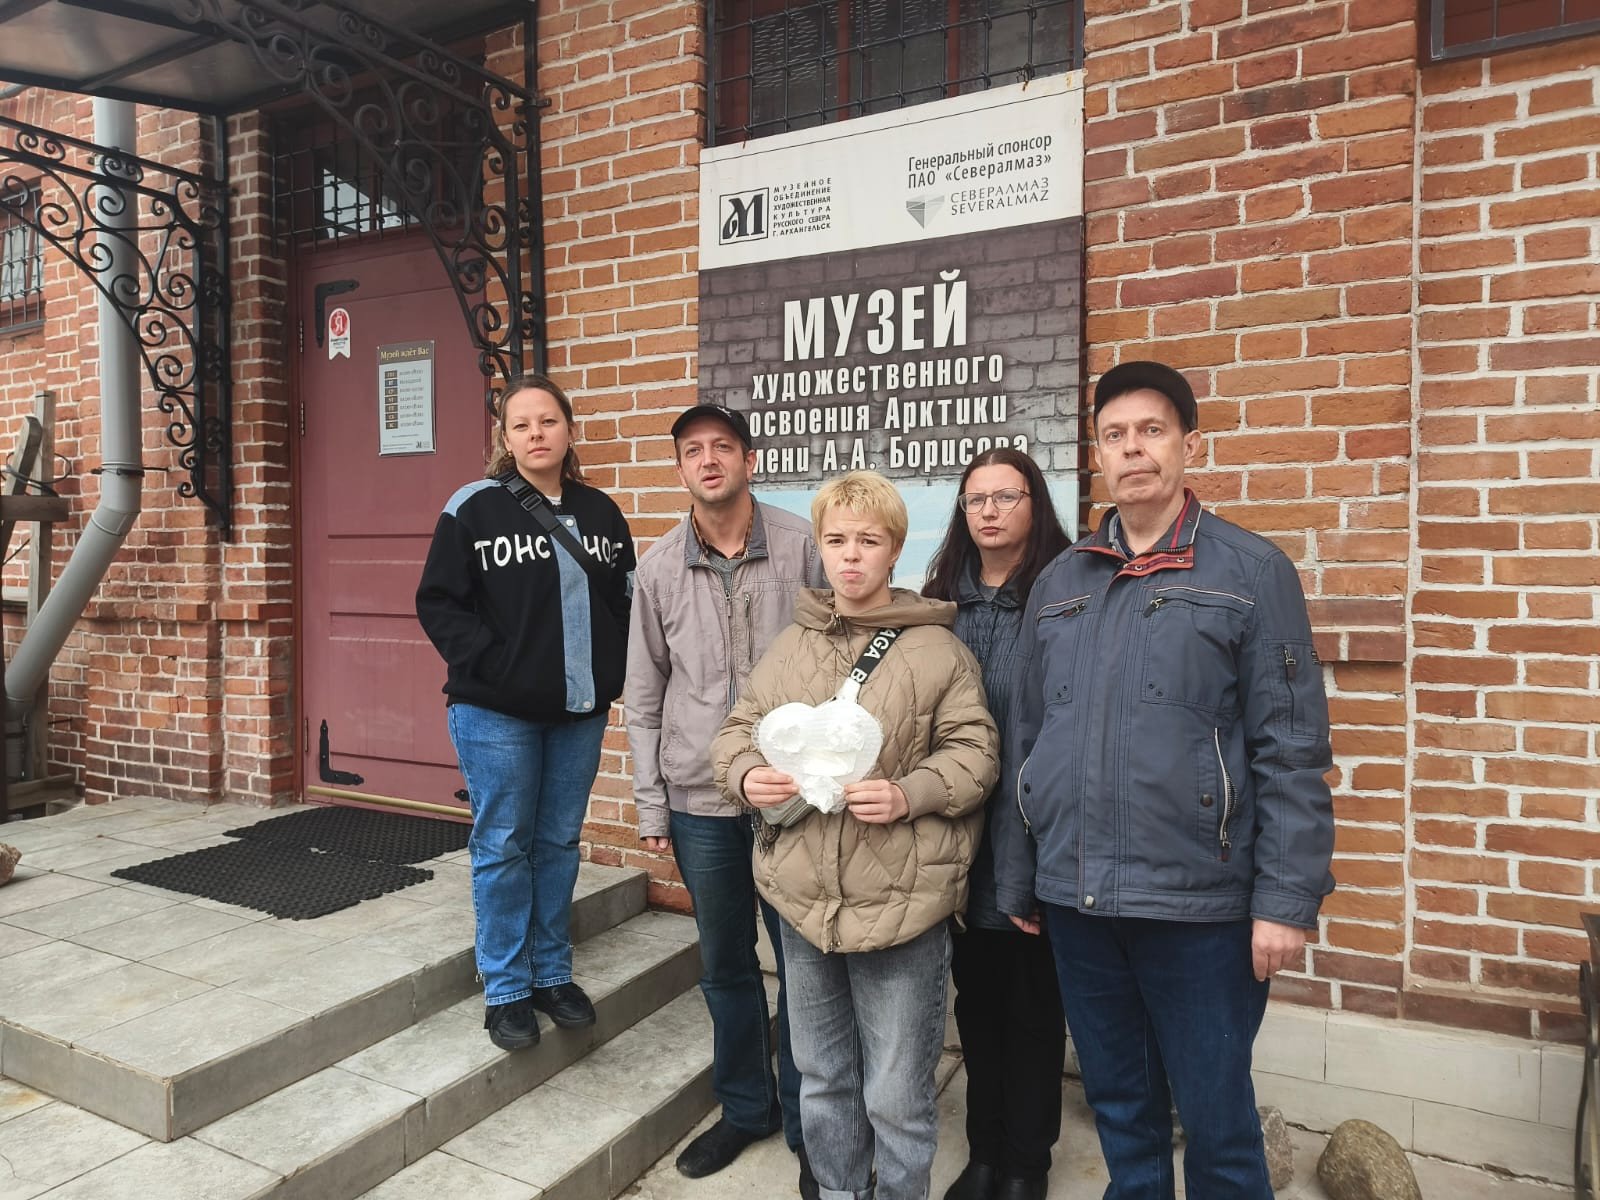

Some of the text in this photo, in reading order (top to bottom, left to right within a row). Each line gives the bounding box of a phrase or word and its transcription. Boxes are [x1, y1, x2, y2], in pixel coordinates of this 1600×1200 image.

[909, 135, 1052, 171] Генеральный спонсор
[909, 154, 1051, 188] ПАО «Севералмаз»
[774, 178, 831, 193] МУЗЕЙНОЕ
[774, 187, 831, 202] ОБЪЕДИНЕНИЕ
[951, 177, 1049, 203] СЕВЕРАЛМАЗ
[774, 196, 831, 211] ХУДОЖЕСТВЕННАЯ
[774, 205, 831, 220] КУЛЬТУРА
[952, 190, 1049, 215] SEVERALMAZ
[774, 214, 831, 229] РУССКОГО СЕВЕРА
[780, 223, 831, 236] АРХАНГЕЛЬСК
[784, 269, 967, 361] МУЗЕЙ
[752, 354, 1003, 403] художественного
[750, 395, 1007, 438] освоения Арктики
[823, 438, 876, 472] А.А.
